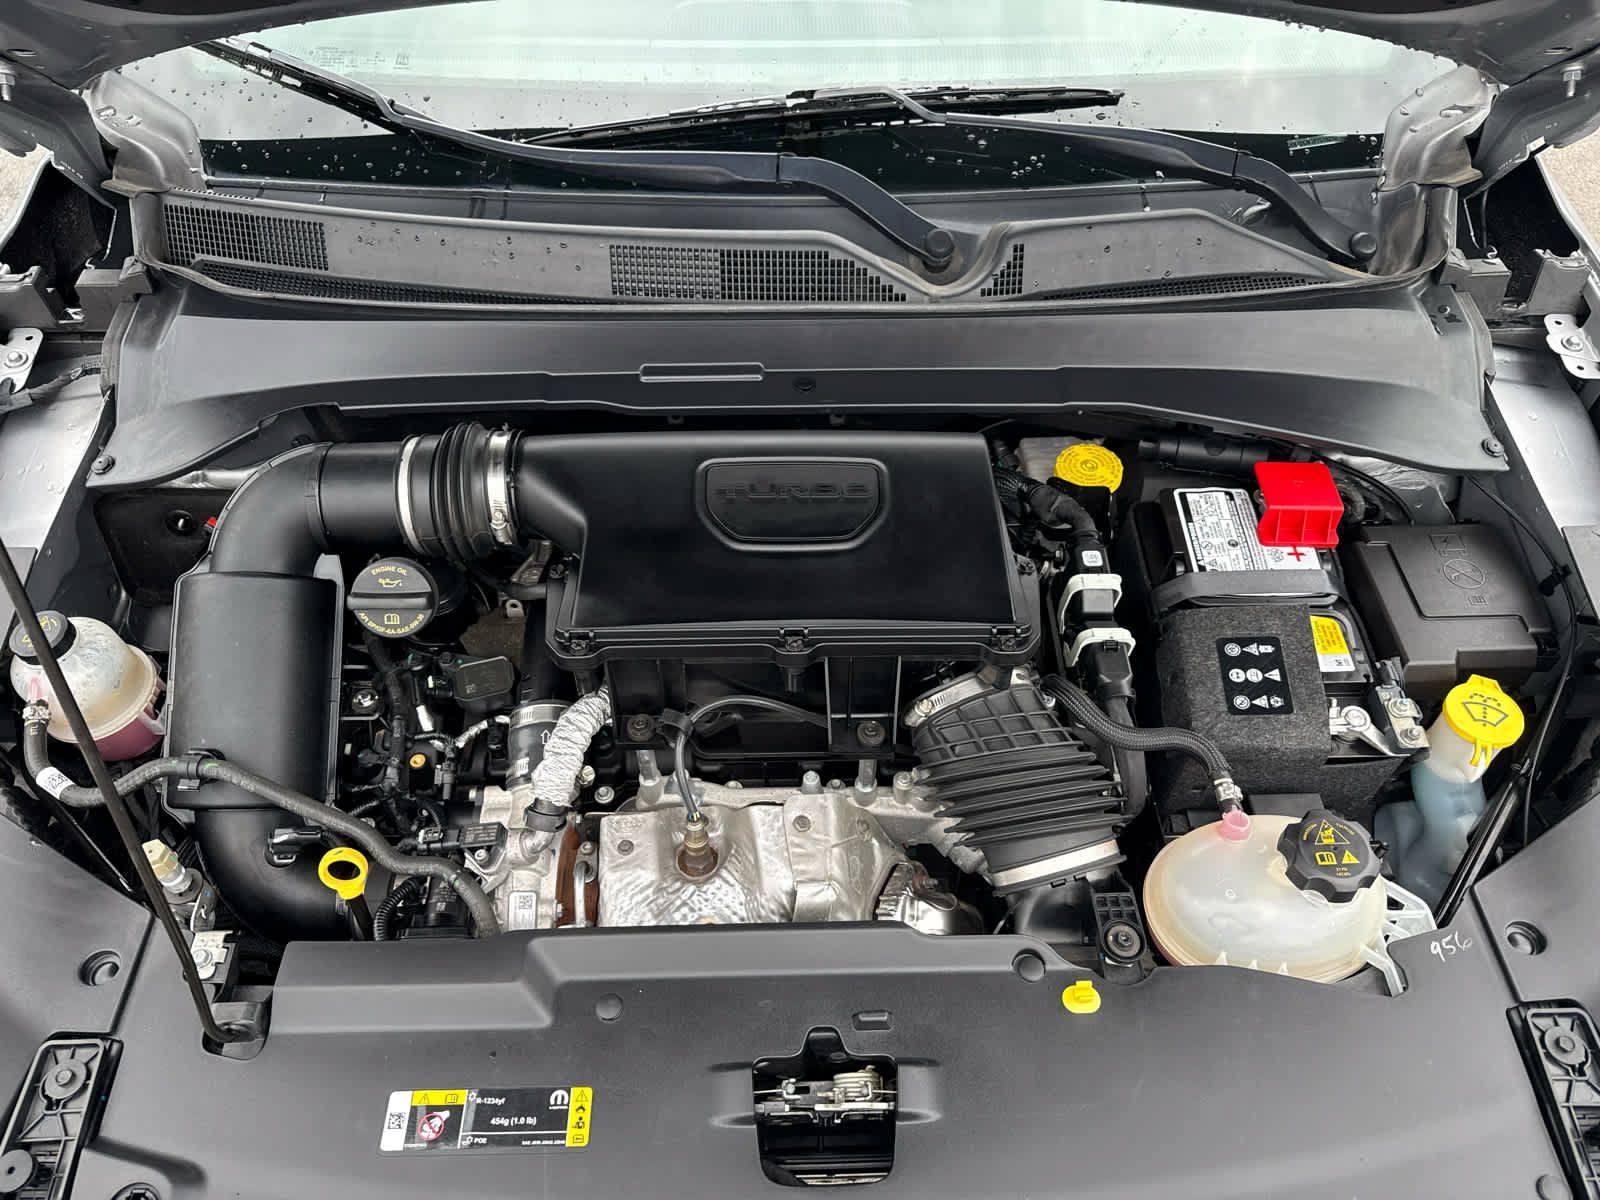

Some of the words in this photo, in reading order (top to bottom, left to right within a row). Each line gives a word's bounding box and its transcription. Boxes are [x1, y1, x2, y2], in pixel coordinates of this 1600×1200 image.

[371, 566, 396, 575] ENGINE
[397, 567, 407, 576] OIL
[1430, 930, 1473, 963] 956
[476, 1097, 506, 1106] R-1234yf
[490, 1117, 510, 1127] 454g
[510, 1116, 525, 1126] (1.0
[526, 1116, 537, 1126] lb)
